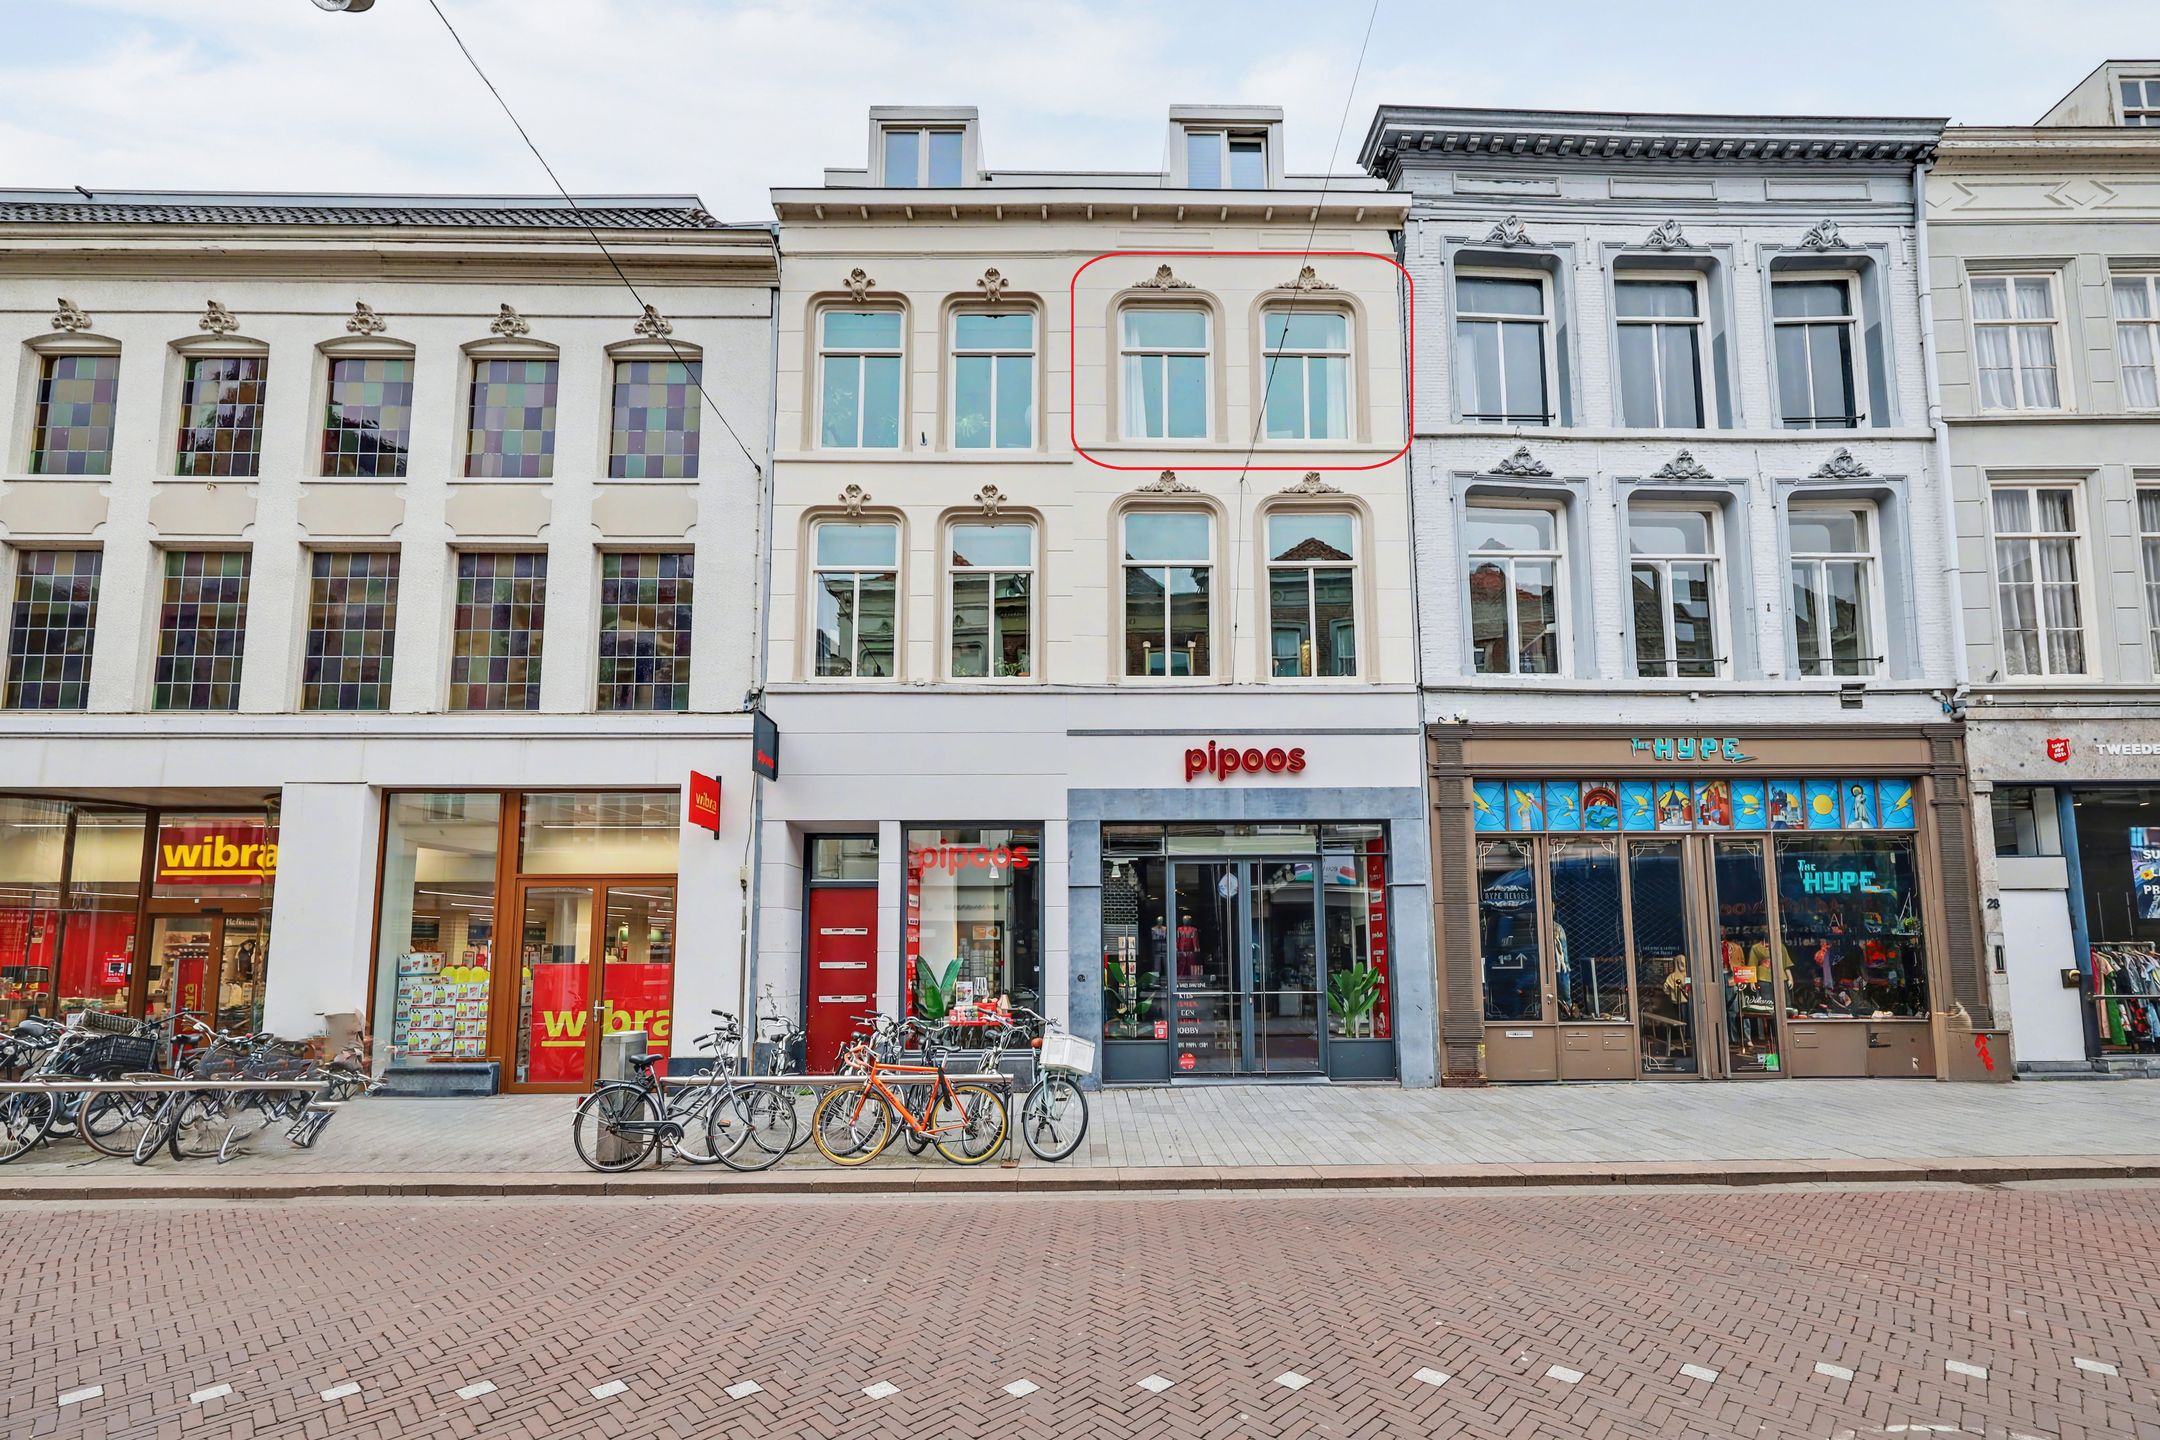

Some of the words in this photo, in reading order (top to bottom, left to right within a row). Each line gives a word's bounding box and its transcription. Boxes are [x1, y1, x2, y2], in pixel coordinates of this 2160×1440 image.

[1185, 739, 1307, 782] pipoos
[1653, 737, 1757, 763] HYPE
[2096, 744, 2160, 756] TWEEDE
[695, 792, 717, 811] wibra
[163, 836, 279, 868] wibra
[918, 838, 1029, 877] pipoos
[1803, 871, 1881, 894] HYPE
[1986, 898, 2000, 909] 28
[543, 1000, 669, 1036] wbra
